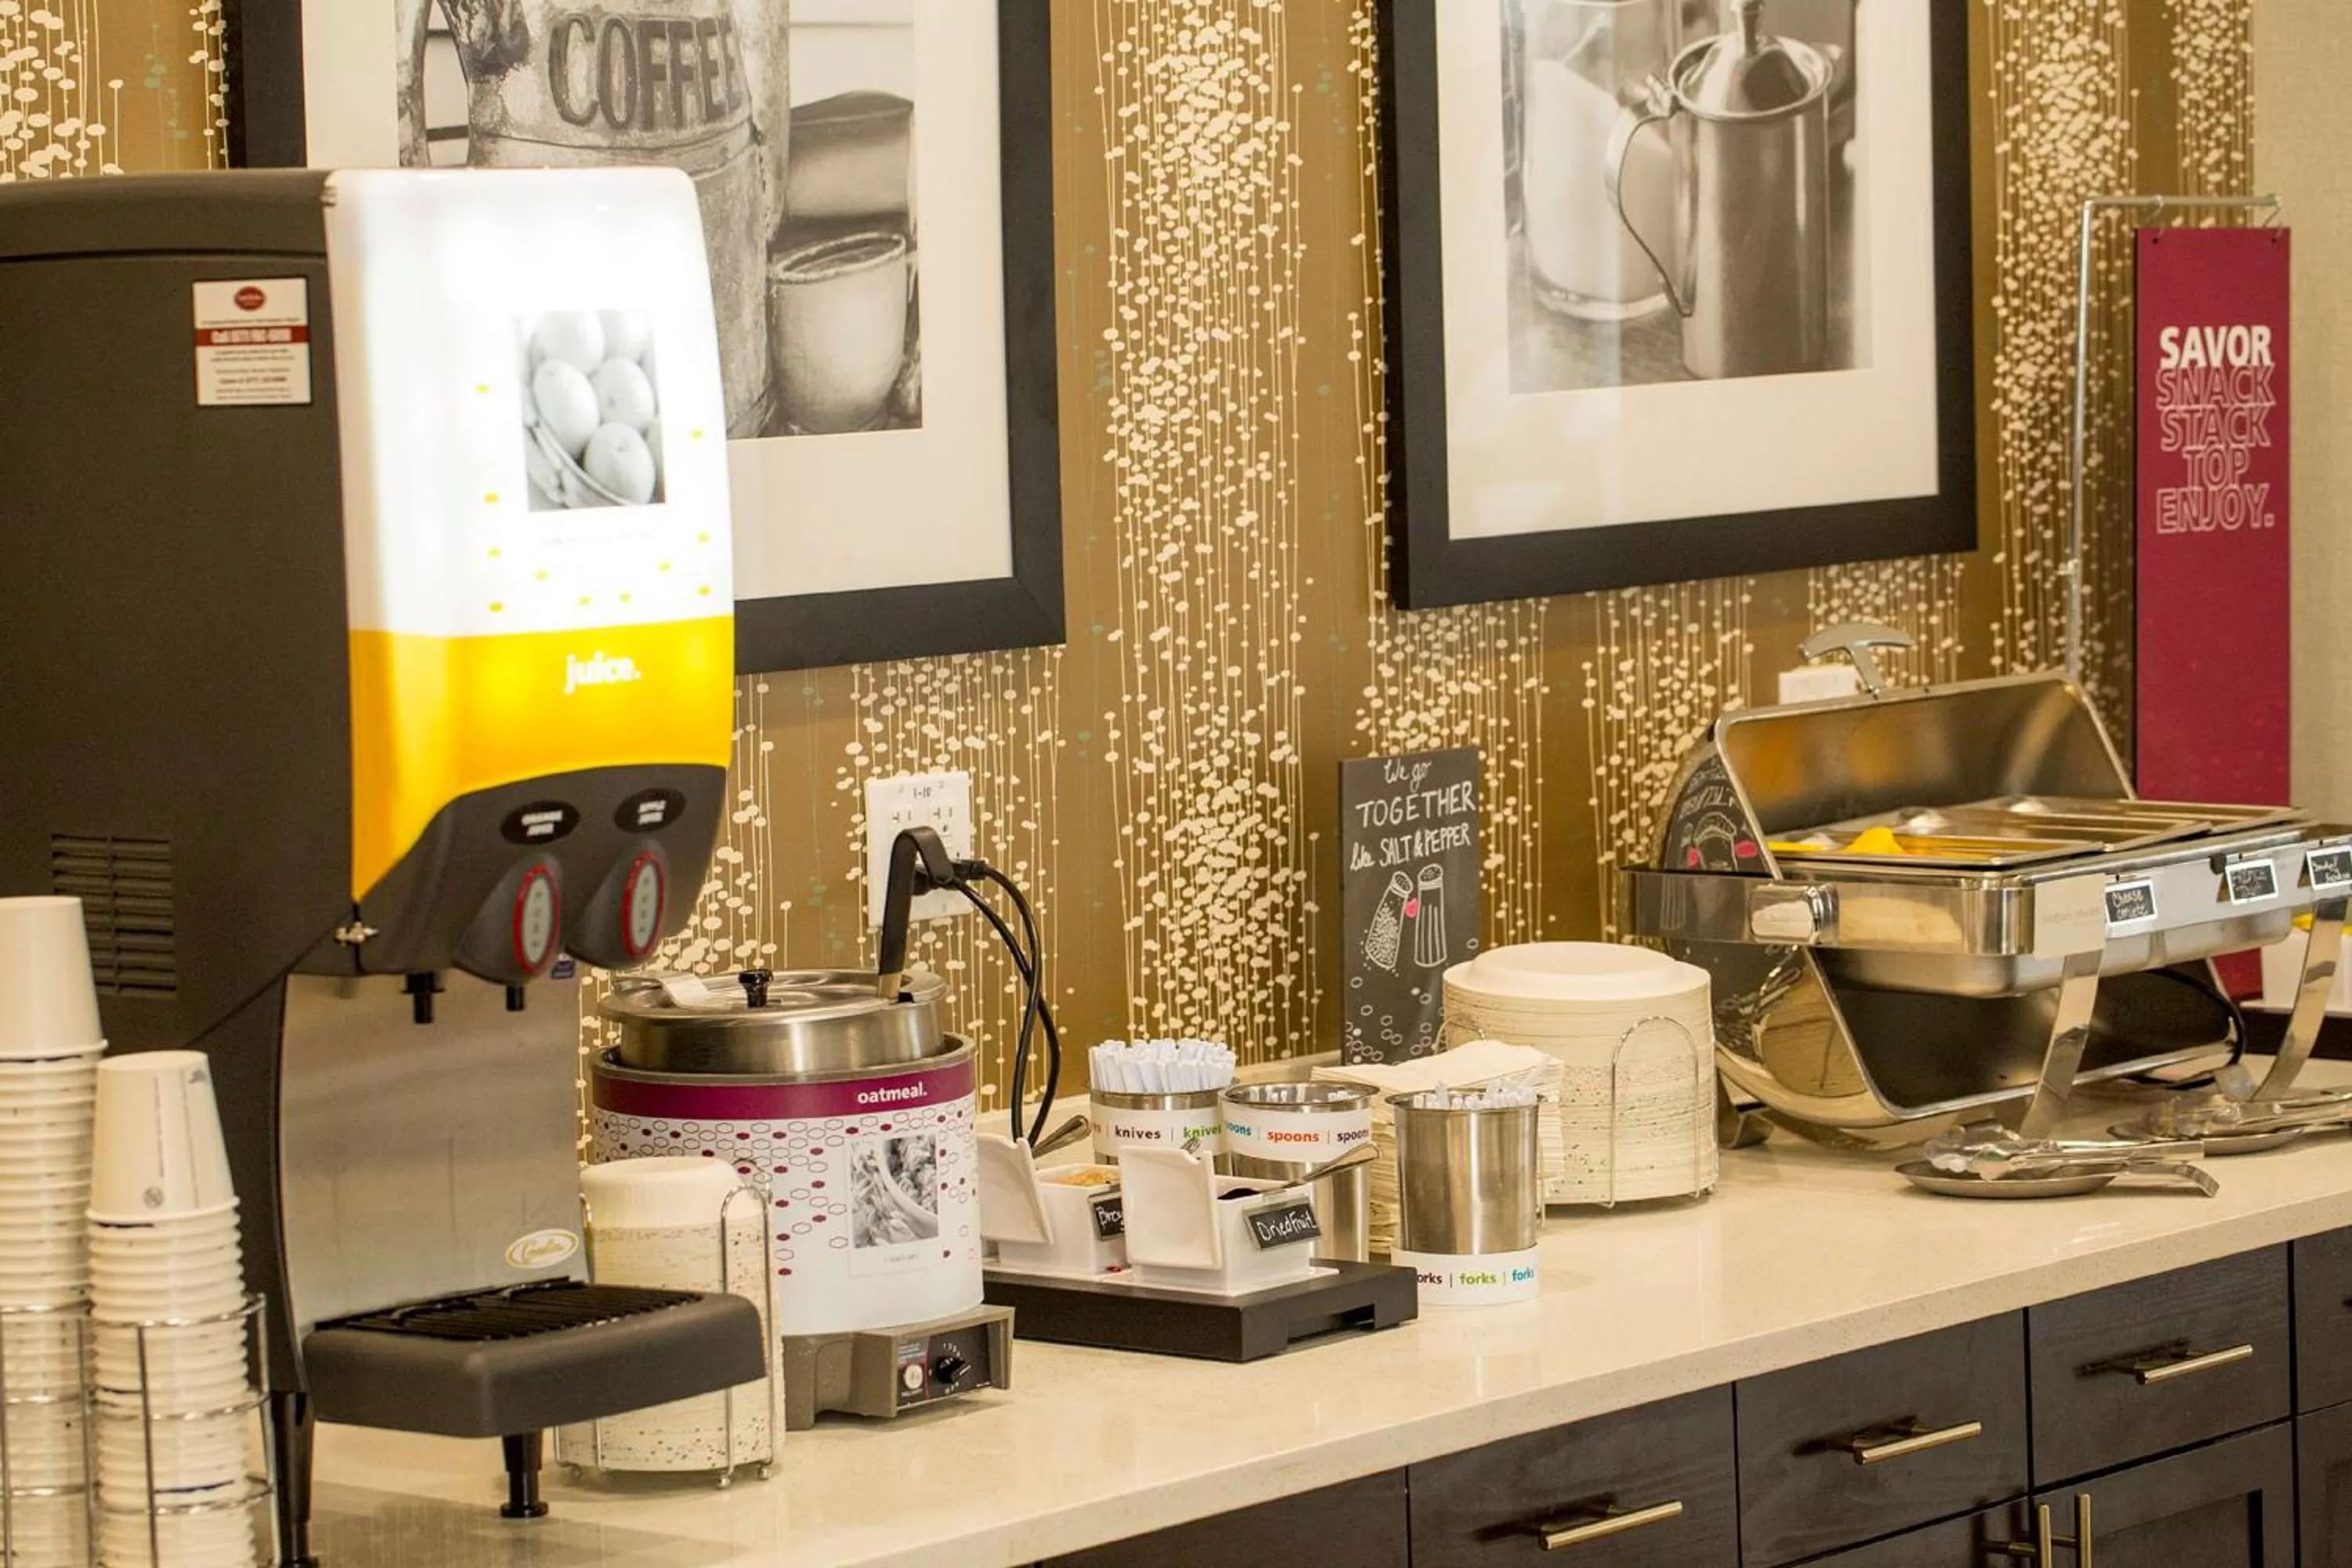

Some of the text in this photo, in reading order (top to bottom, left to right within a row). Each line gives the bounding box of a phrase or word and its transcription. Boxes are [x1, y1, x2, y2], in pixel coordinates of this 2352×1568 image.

[2159, 325, 2273, 368] SAVOR
[2156, 363, 2276, 409] SNACK
[2160, 405, 2272, 452] STACK
[2182, 444, 2249, 491] TOP
[2157, 483, 2275, 534] ENJOY.
[564, 651, 641, 695] juice.
[1410, 761, 1432, 792] go
[1355, 781, 1476, 828] TOGETHER
[1379, 835, 1412, 867] SALT
[1424, 822, 1472, 857] PEPPER
[857, 1081, 928, 1105] oatmeal.
[1115, 1124, 1161, 1139] knives
[1267, 1130, 1319, 1143] spoons
[1337, 1128, 1369, 1144] spoon
[1417, 1266, 1534, 1285] orks forks fork
